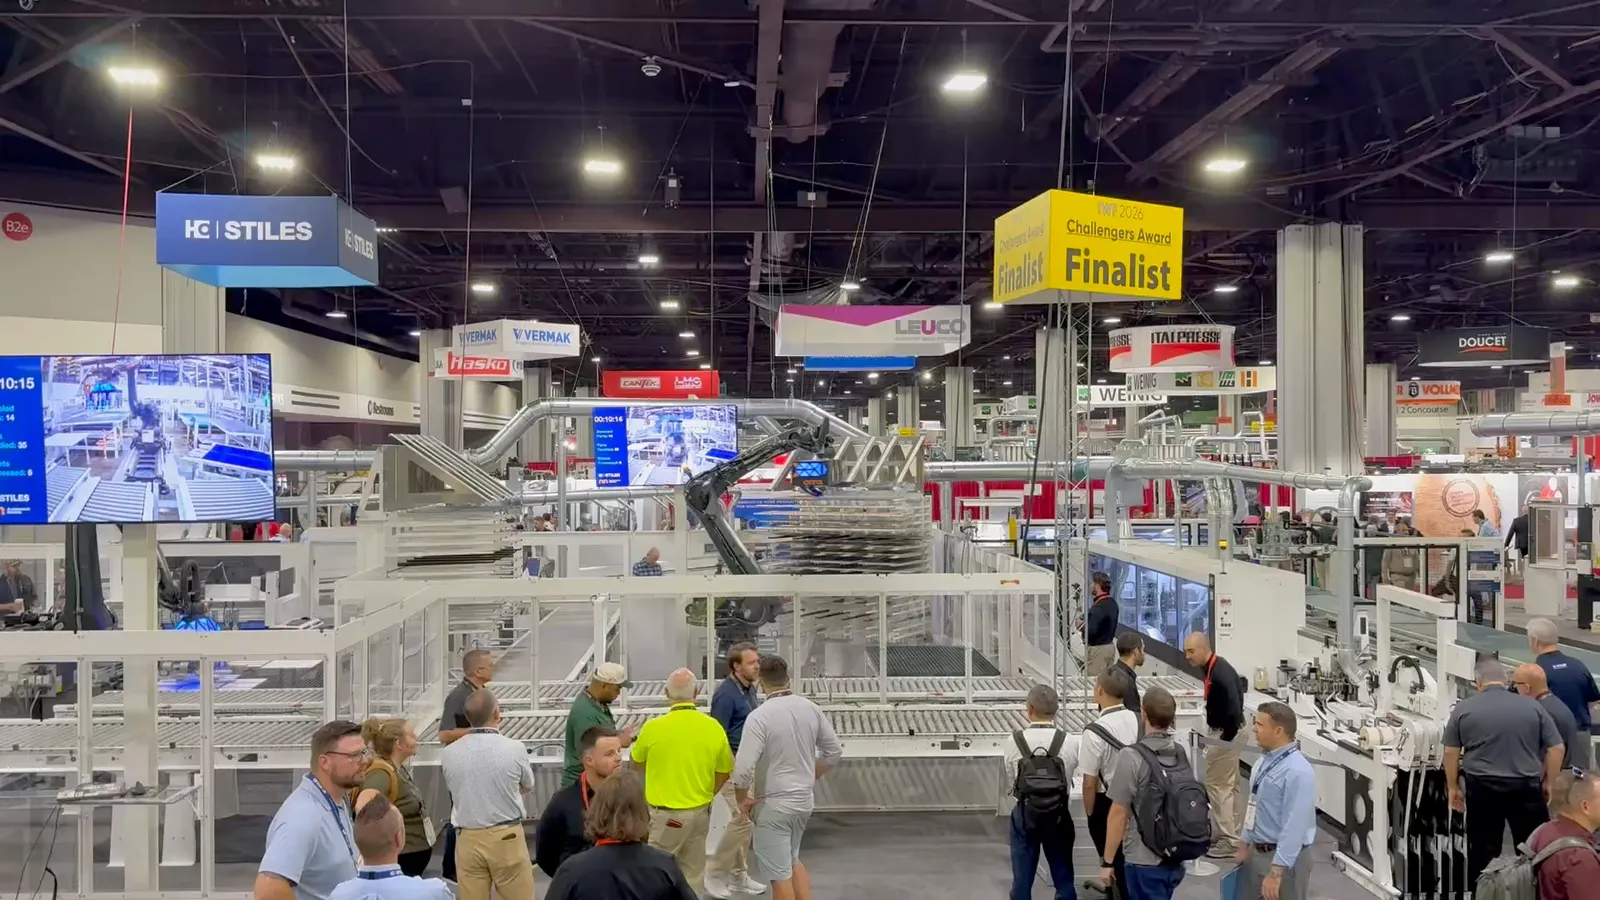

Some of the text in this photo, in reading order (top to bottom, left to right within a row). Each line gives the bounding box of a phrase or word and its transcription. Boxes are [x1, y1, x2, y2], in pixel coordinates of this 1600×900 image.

[1119, 204, 1144, 221] 2026
[6, 219, 29, 233] B2e
[224, 220, 313, 241] STILES
[1066, 218, 1172, 245] Challengers Award
[354, 233, 373, 260] STILES
[998, 251, 1044, 296] Finalist
[1065, 247, 1171, 291] Finalist
[895, 319, 967, 335] LEUCO
[465, 328, 497, 343] VERMAK
[525, 329, 571, 344] VERMAK
[1150, 331, 1221, 344] ITALPRESSE
[1458, 336, 1507, 347] DOUCET
[1133, 372, 1157, 391] WEINIG
[372, 402, 395, 417] Restrooms
[1400, 406, 1449, 414] 2 Concourse
